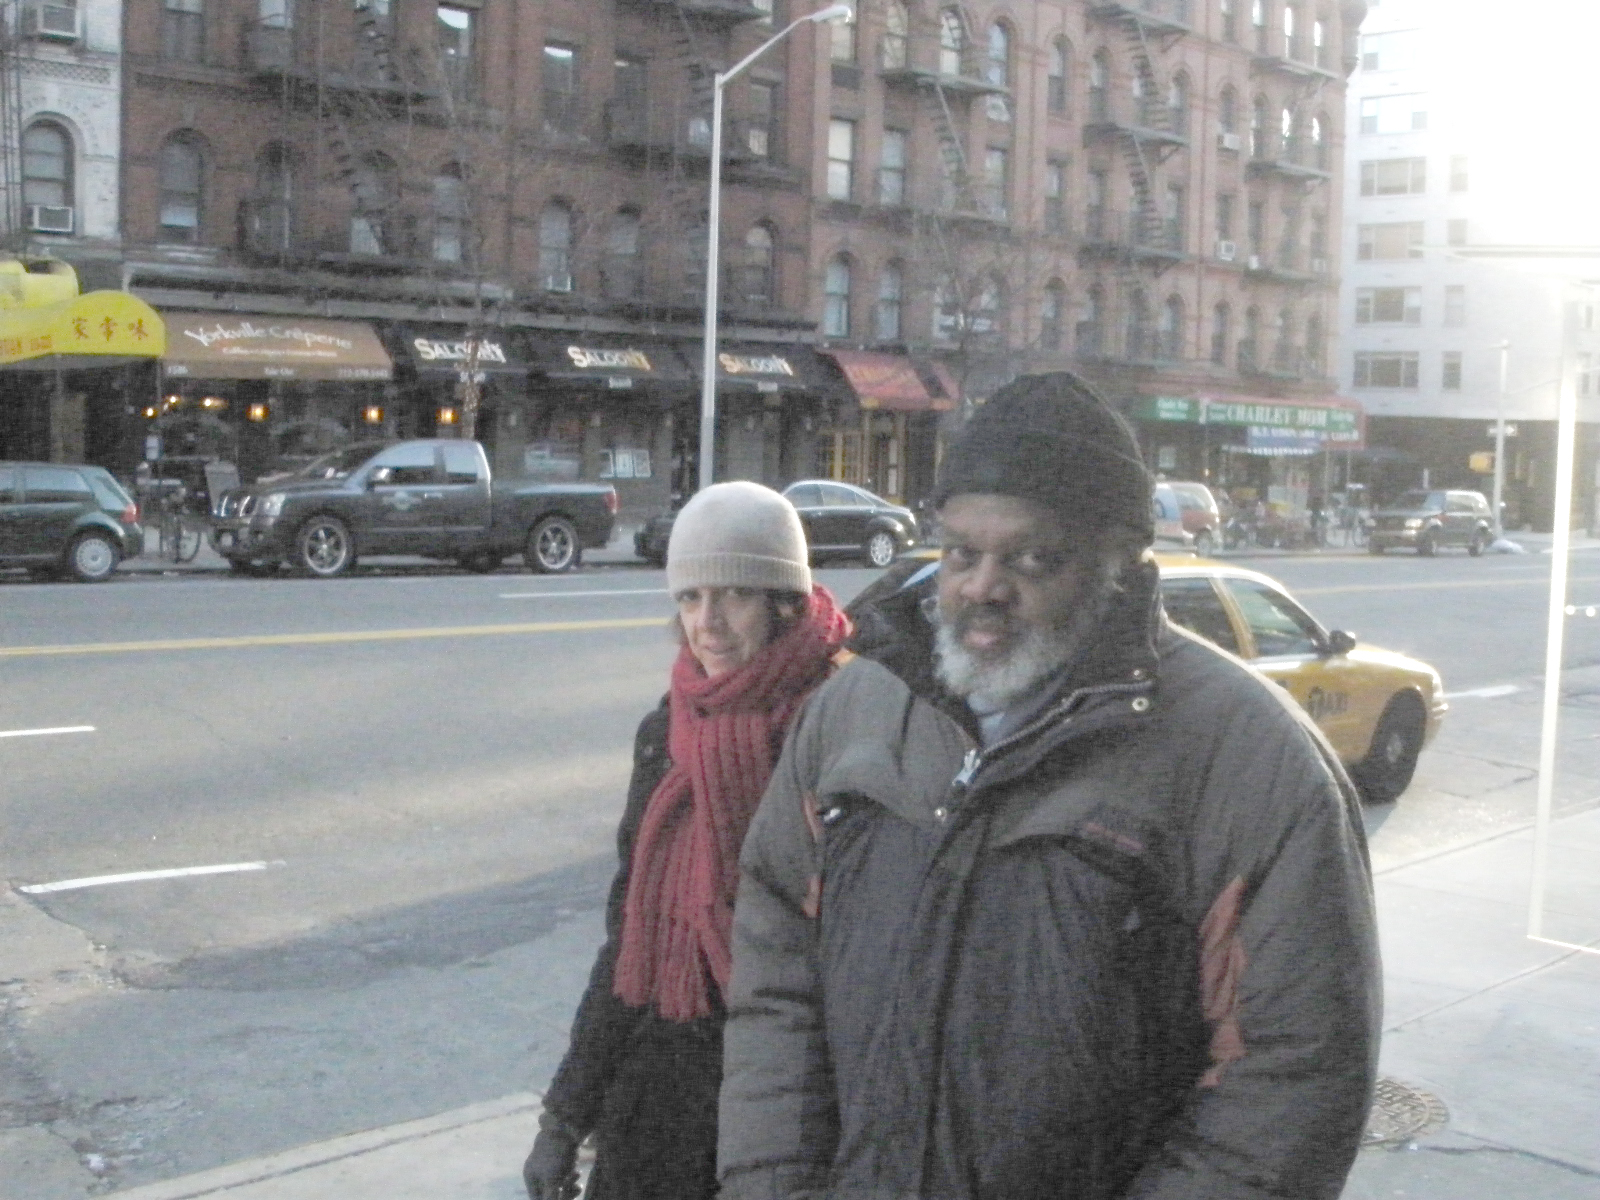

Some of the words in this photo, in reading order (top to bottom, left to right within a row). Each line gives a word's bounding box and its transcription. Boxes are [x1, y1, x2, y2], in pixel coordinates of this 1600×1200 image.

[414, 338, 507, 363] SALON
[567, 343, 651, 371] SALOON
[718, 352, 794, 376] SALOON
